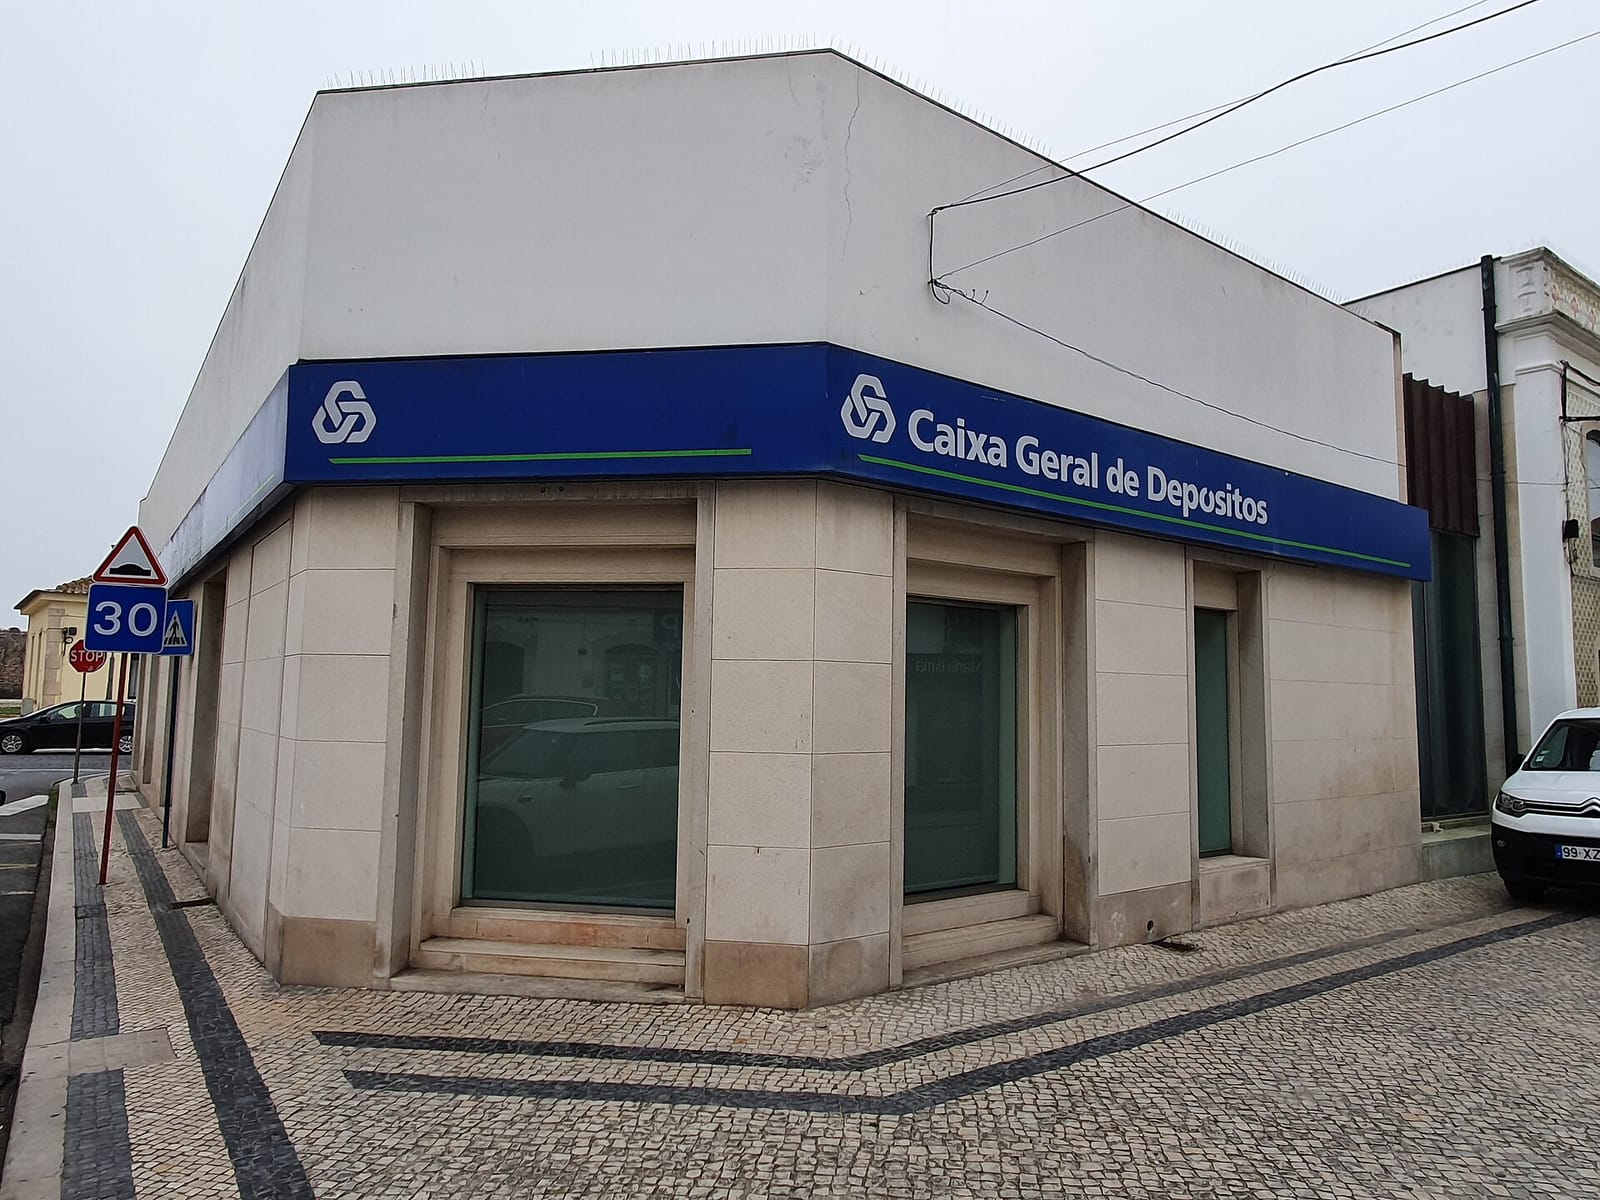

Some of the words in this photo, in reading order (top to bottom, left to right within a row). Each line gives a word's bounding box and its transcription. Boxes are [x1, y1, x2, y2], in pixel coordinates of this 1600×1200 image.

[908, 409, 1008, 468] Caixa
[1015, 435, 1099, 489] Geral
[1106, 458, 1140, 497] de
[1147, 465, 1269, 525] Depositos
[93, 601, 158, 637] 30
[70, 650, 104, 663] STOP
